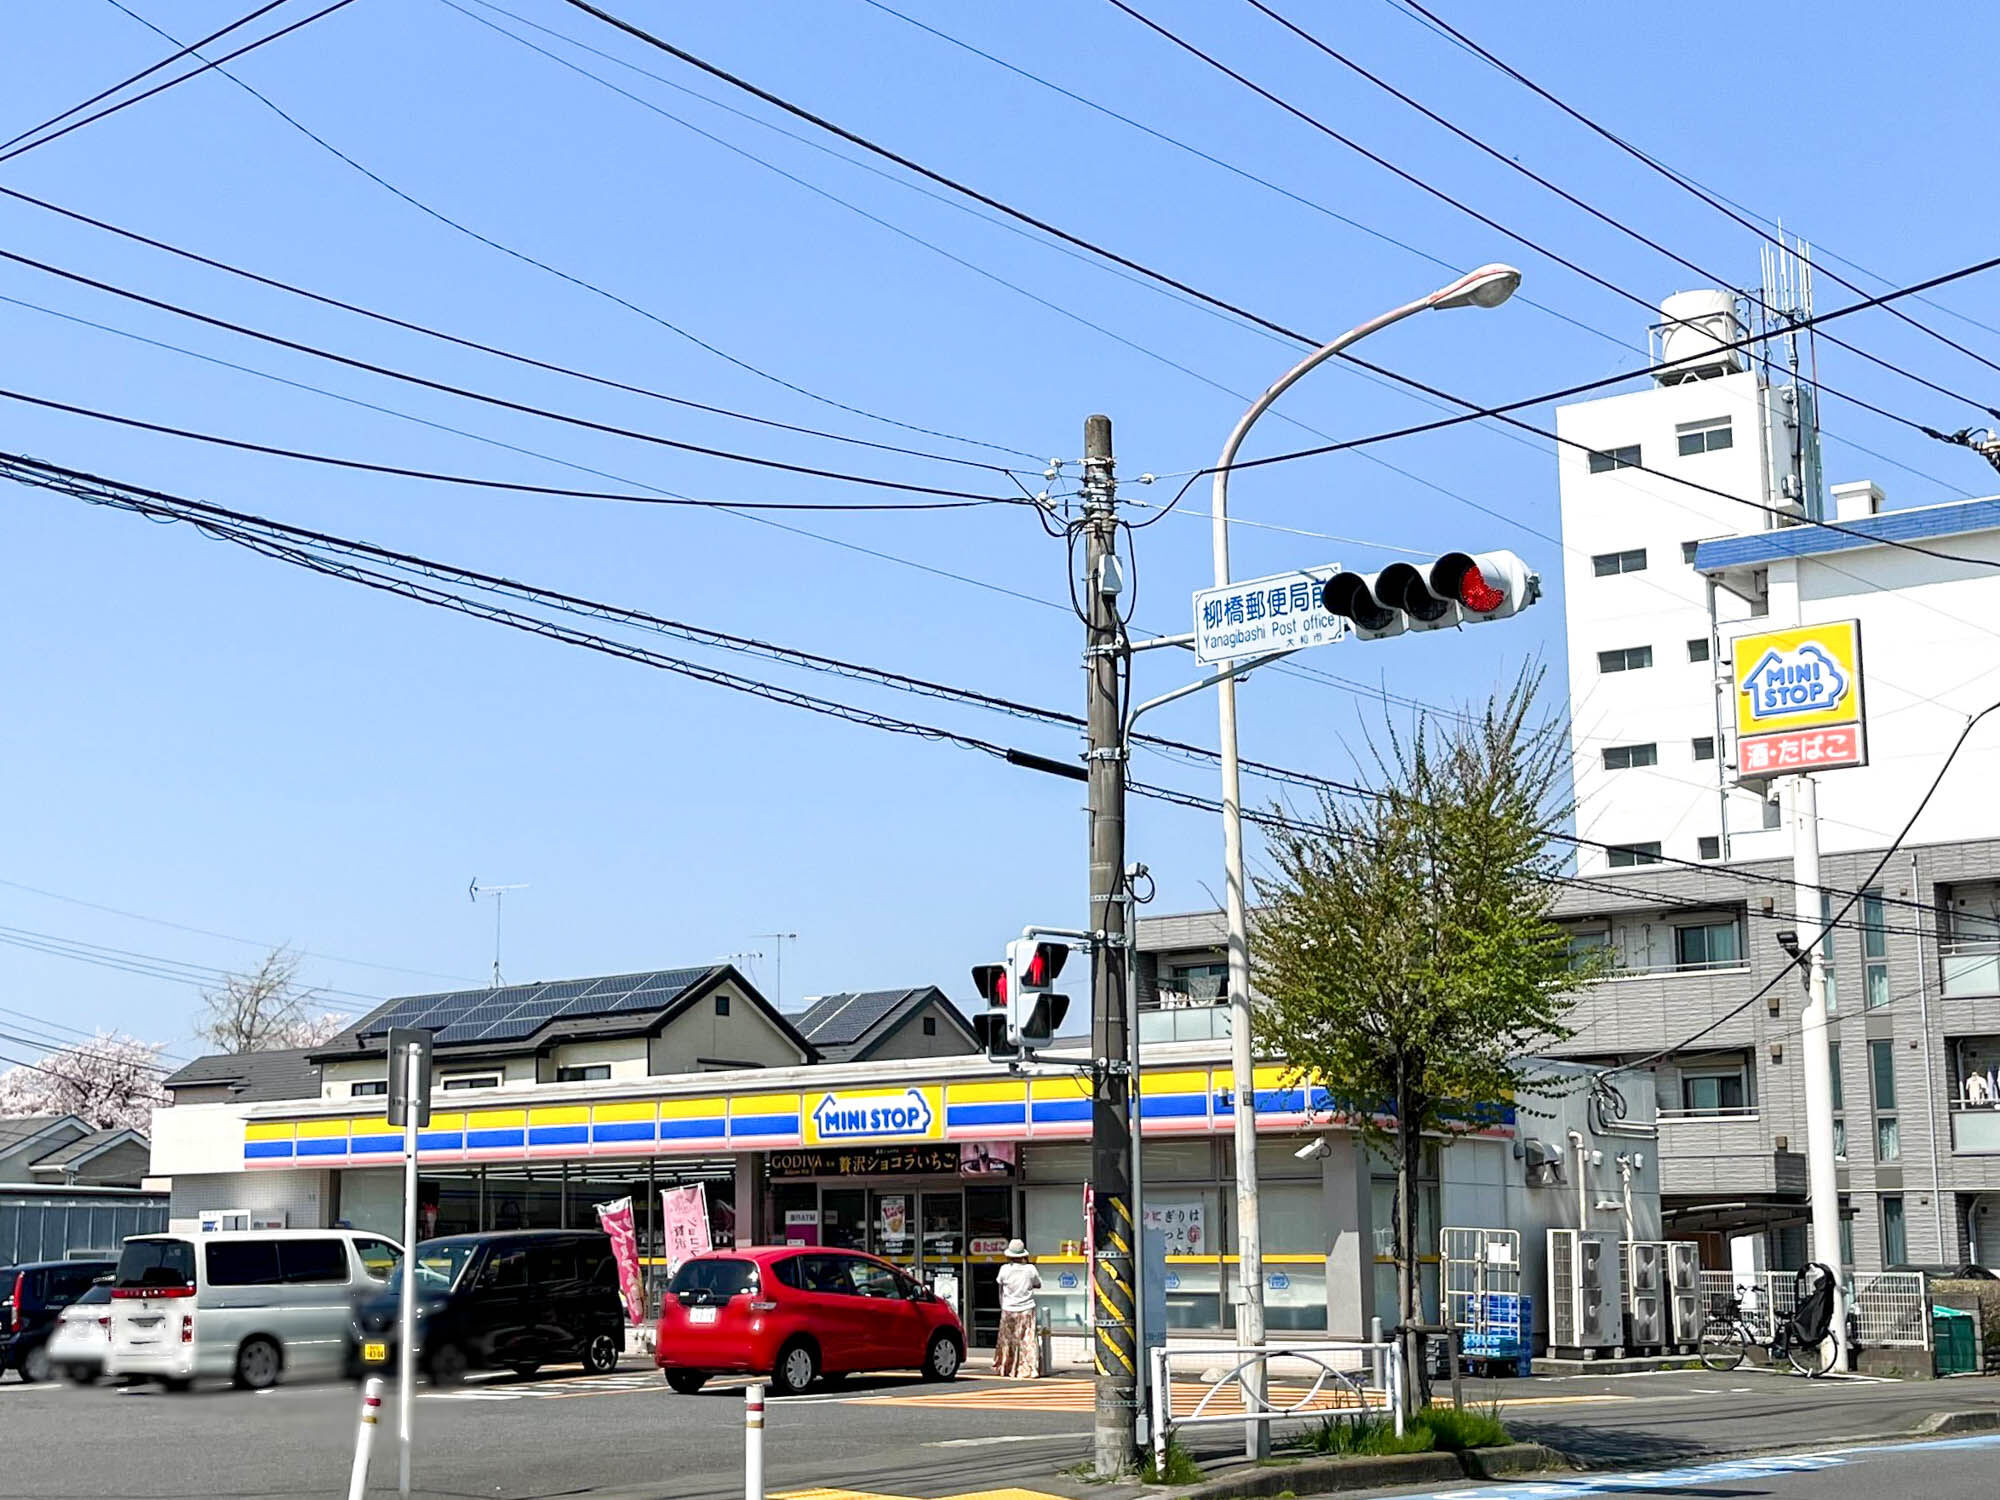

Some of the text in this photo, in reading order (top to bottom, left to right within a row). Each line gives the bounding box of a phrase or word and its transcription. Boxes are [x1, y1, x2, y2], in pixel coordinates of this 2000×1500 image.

[1203, 614, 1335, 649] Yanagibashi Post office
[1766, 662, 1820, 688] MINI
[1765, 682, 1824, 708] STOP
[825, 1107, 920, 1131] MINI STOP
[771, 1155, 822, 1169] GODIVA
